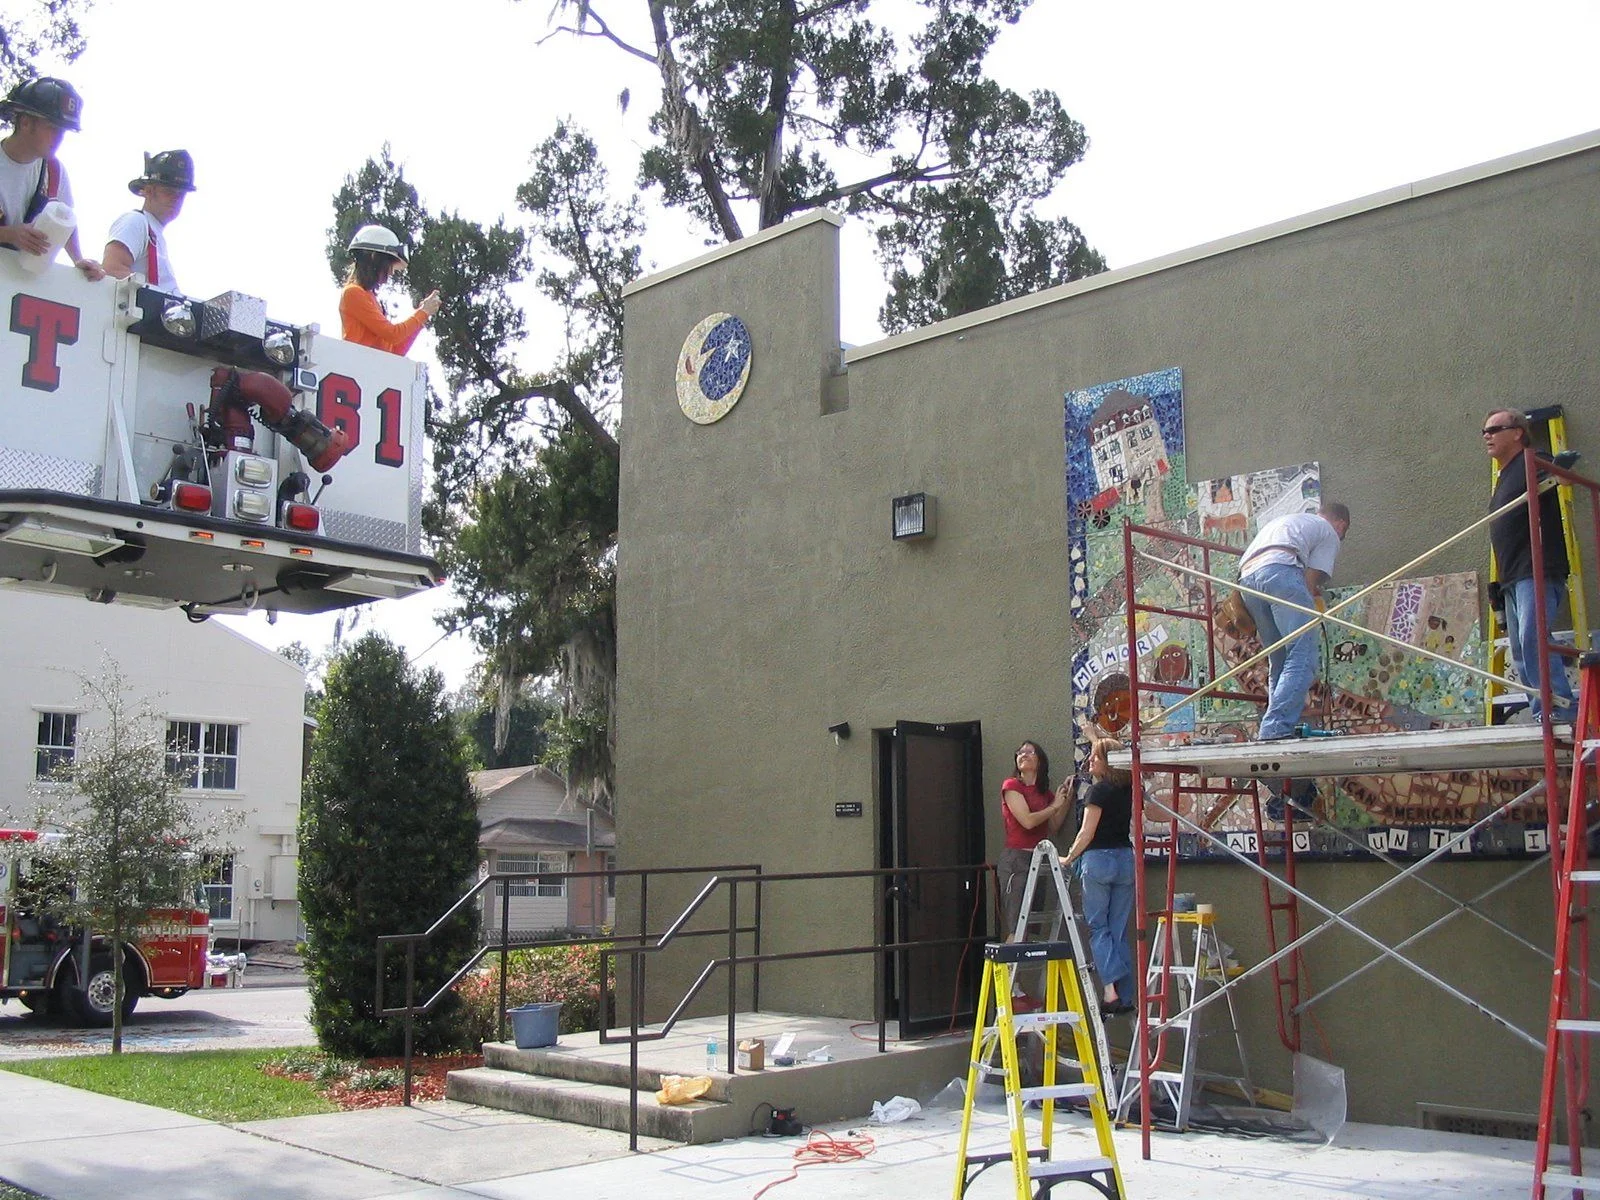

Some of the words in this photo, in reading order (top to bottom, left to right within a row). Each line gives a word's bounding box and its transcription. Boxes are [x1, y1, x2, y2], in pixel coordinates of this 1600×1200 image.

[10, 292, 80, 392] T
[316, 372, 404, 468] 61
[1076, 630, 1162, 688] MEMORY
